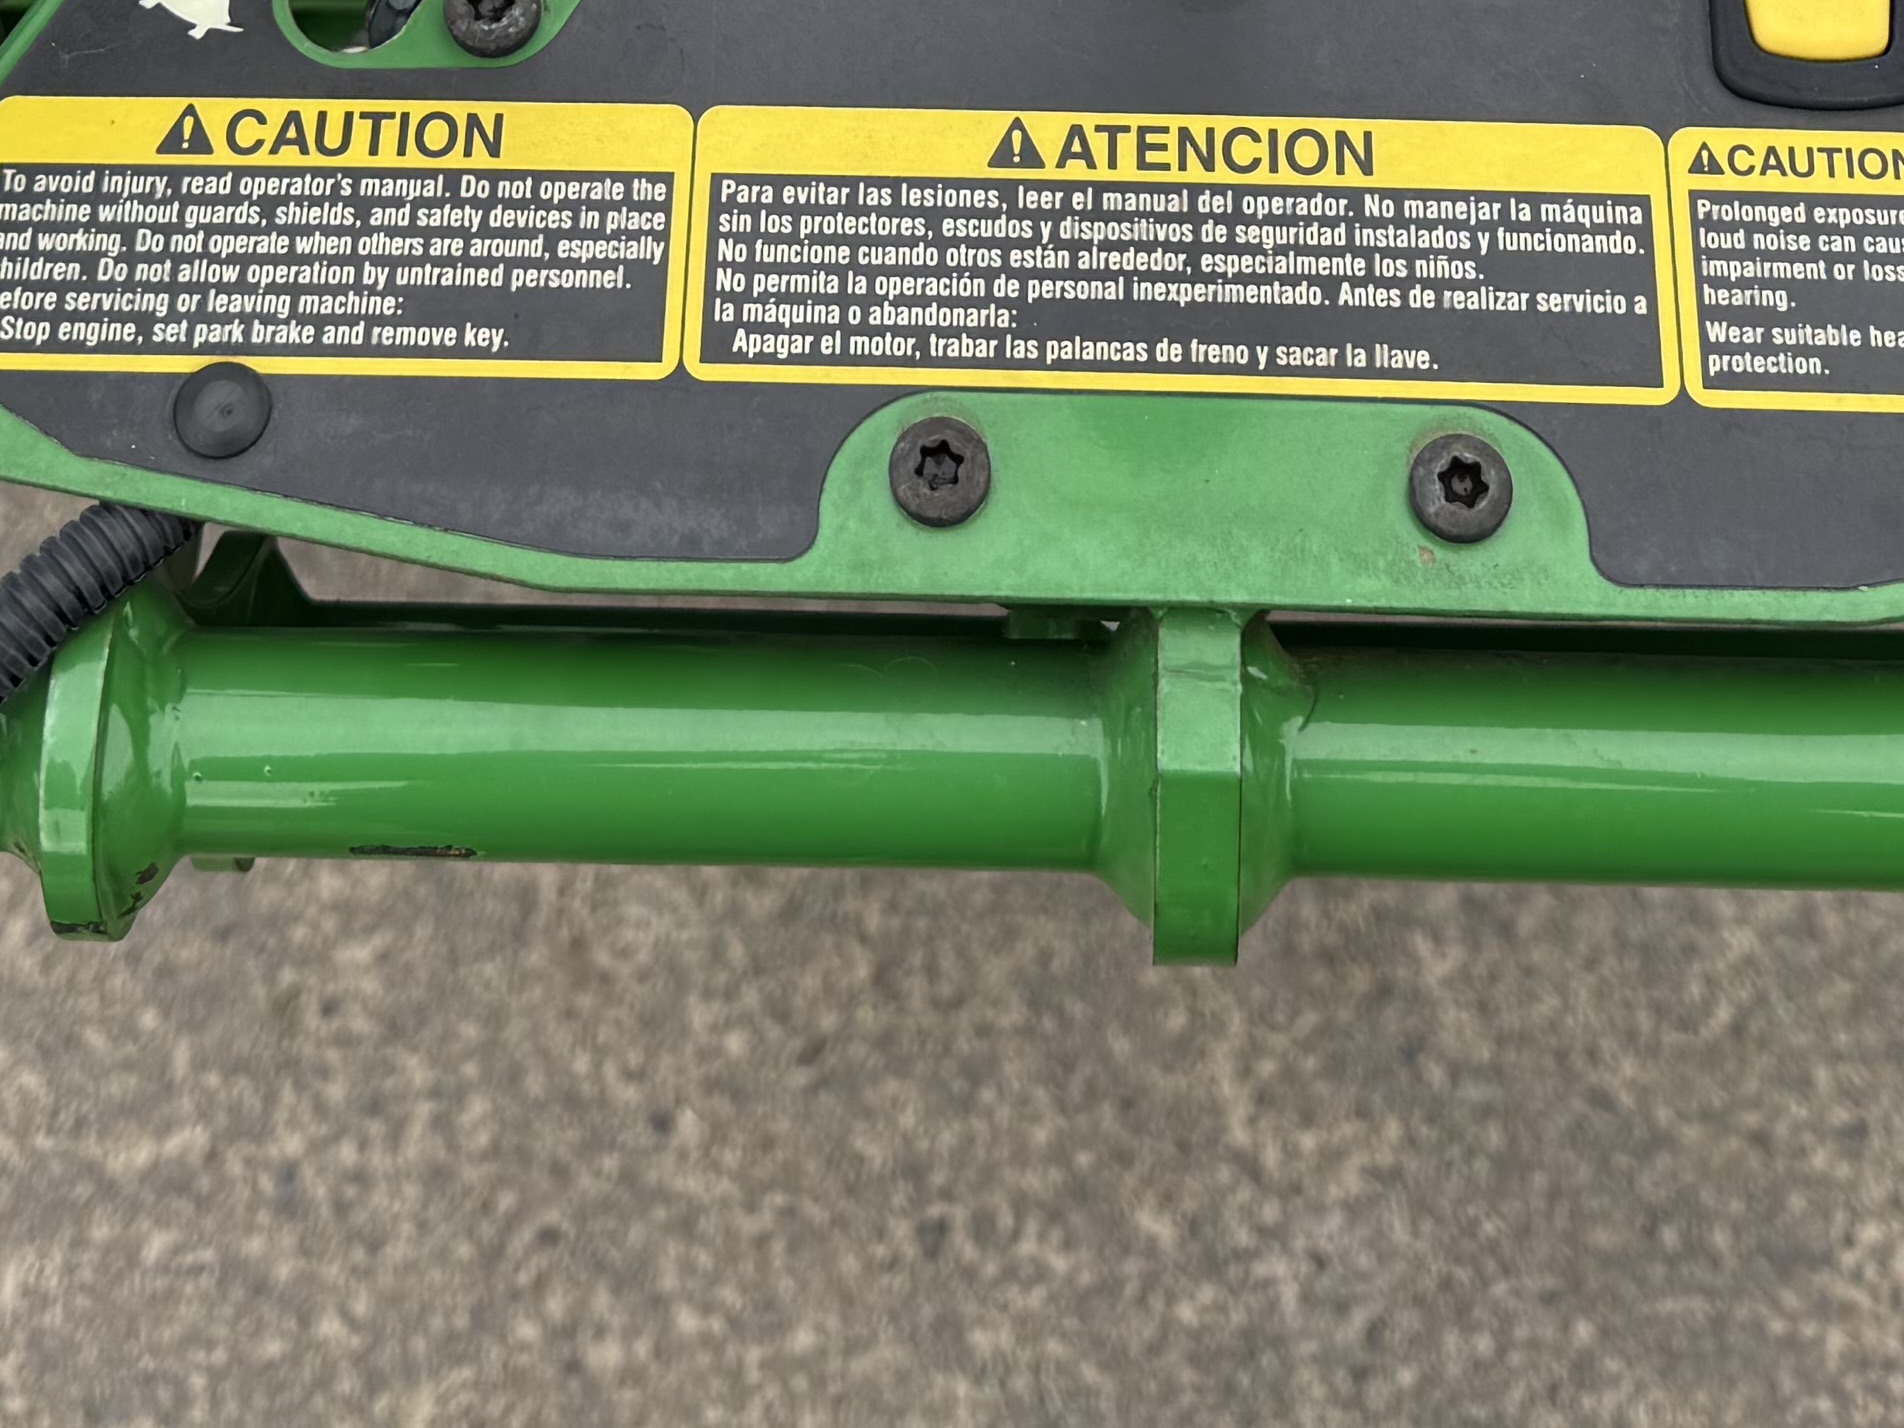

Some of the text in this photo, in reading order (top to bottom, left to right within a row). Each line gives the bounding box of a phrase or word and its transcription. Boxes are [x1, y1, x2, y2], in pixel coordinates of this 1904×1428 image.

[225, 109, 504, 159] CAUTION
[1055, 124, 1374, 176] ATENCION
[2, 168, 26, 193] To
[34, 169, 95, 193] avoid
[102, 169, 171, 200] injury,
[182, 171, 232, 195] read
[239, 172, 352, 201] operator's
[460, 174, 489, 199] Do
[498, 176, 532, 199] not
[540, 177, 624, 205] operate
[632, 177, 666, 202] the
[721, 179, 1642, 229] Para evitar las lesiones, leer el manual del operador. No manejar la máquina
[99, 198, 179, 224] without
[185, 200, 266, 229] guards,
[275, 201, 361, 229] shields,
[370, 202, 410, 227] and
[417, 203, 482, 233] safety
[489, 203, 572, 230] devices
[578, 205, 599, 230] in
[606, 206, 665, 235] place
[1697, 198, 1806, 228] Prolonged
[38, 227, 126, 257] working.
[135, 228, 164, 253] Do
[170, 229, 204, 254] not
[209, 230, 289, 259] operate
[296, 230, 352, 256] when
[358, 231, 424, 257] others
[429, 237, 463, 257] are
[470, 233, 549, 262] around,
[558, 235, 664, 266] especially
[719, 208, 1644, 256] sin los protectores, escudos y dispositivos de seguridad instalados y funcionando.
[1700, 226, 1745, 250] loud
[1753, 228, 1810, 252] noise
[1818, 234, 1856, 253] can
[97, 257, 128, 282] Do
[135, 258, 171, 283] not
[178, 258, 240, 284] allow
[247, 259, 355, 294] operation
[362, 260, 389, 292] by
[396, 262, 504, 288] untrained
[511, 264, 631, 293] personnel.
[718, 237, 1484, 280] No funcione cuando otros están alrededor, especialmente los niños.
[1702, 254, 1827, 282] impairment
[1832, 263, 1855, 281] or
[65, 287, 169, 318] servicing
[176, 293, 201, 313] or
[207, 288, 290, 320] leaving
[298, 290, 403, 316] machine:
[716, 267, 1647, 315] No permita la operación de personal inexperimentado. Antes de realizar servicio a
[1703, 283, 1795, 312] hearing.
[713, 297, 1017, 329] la máquina o abandonarla:
[0, 315, 508, 353] Stop engine, set park brake and remove key.
[733, 327, 1438, 371] Apagar el motor, trabar las palancas de freno y sacar la llave.
[1706, 320, 1764, 344] Wear
[1772, 323, 1861, 347] suitable
[1709, 351, 1829, 377] protection.
